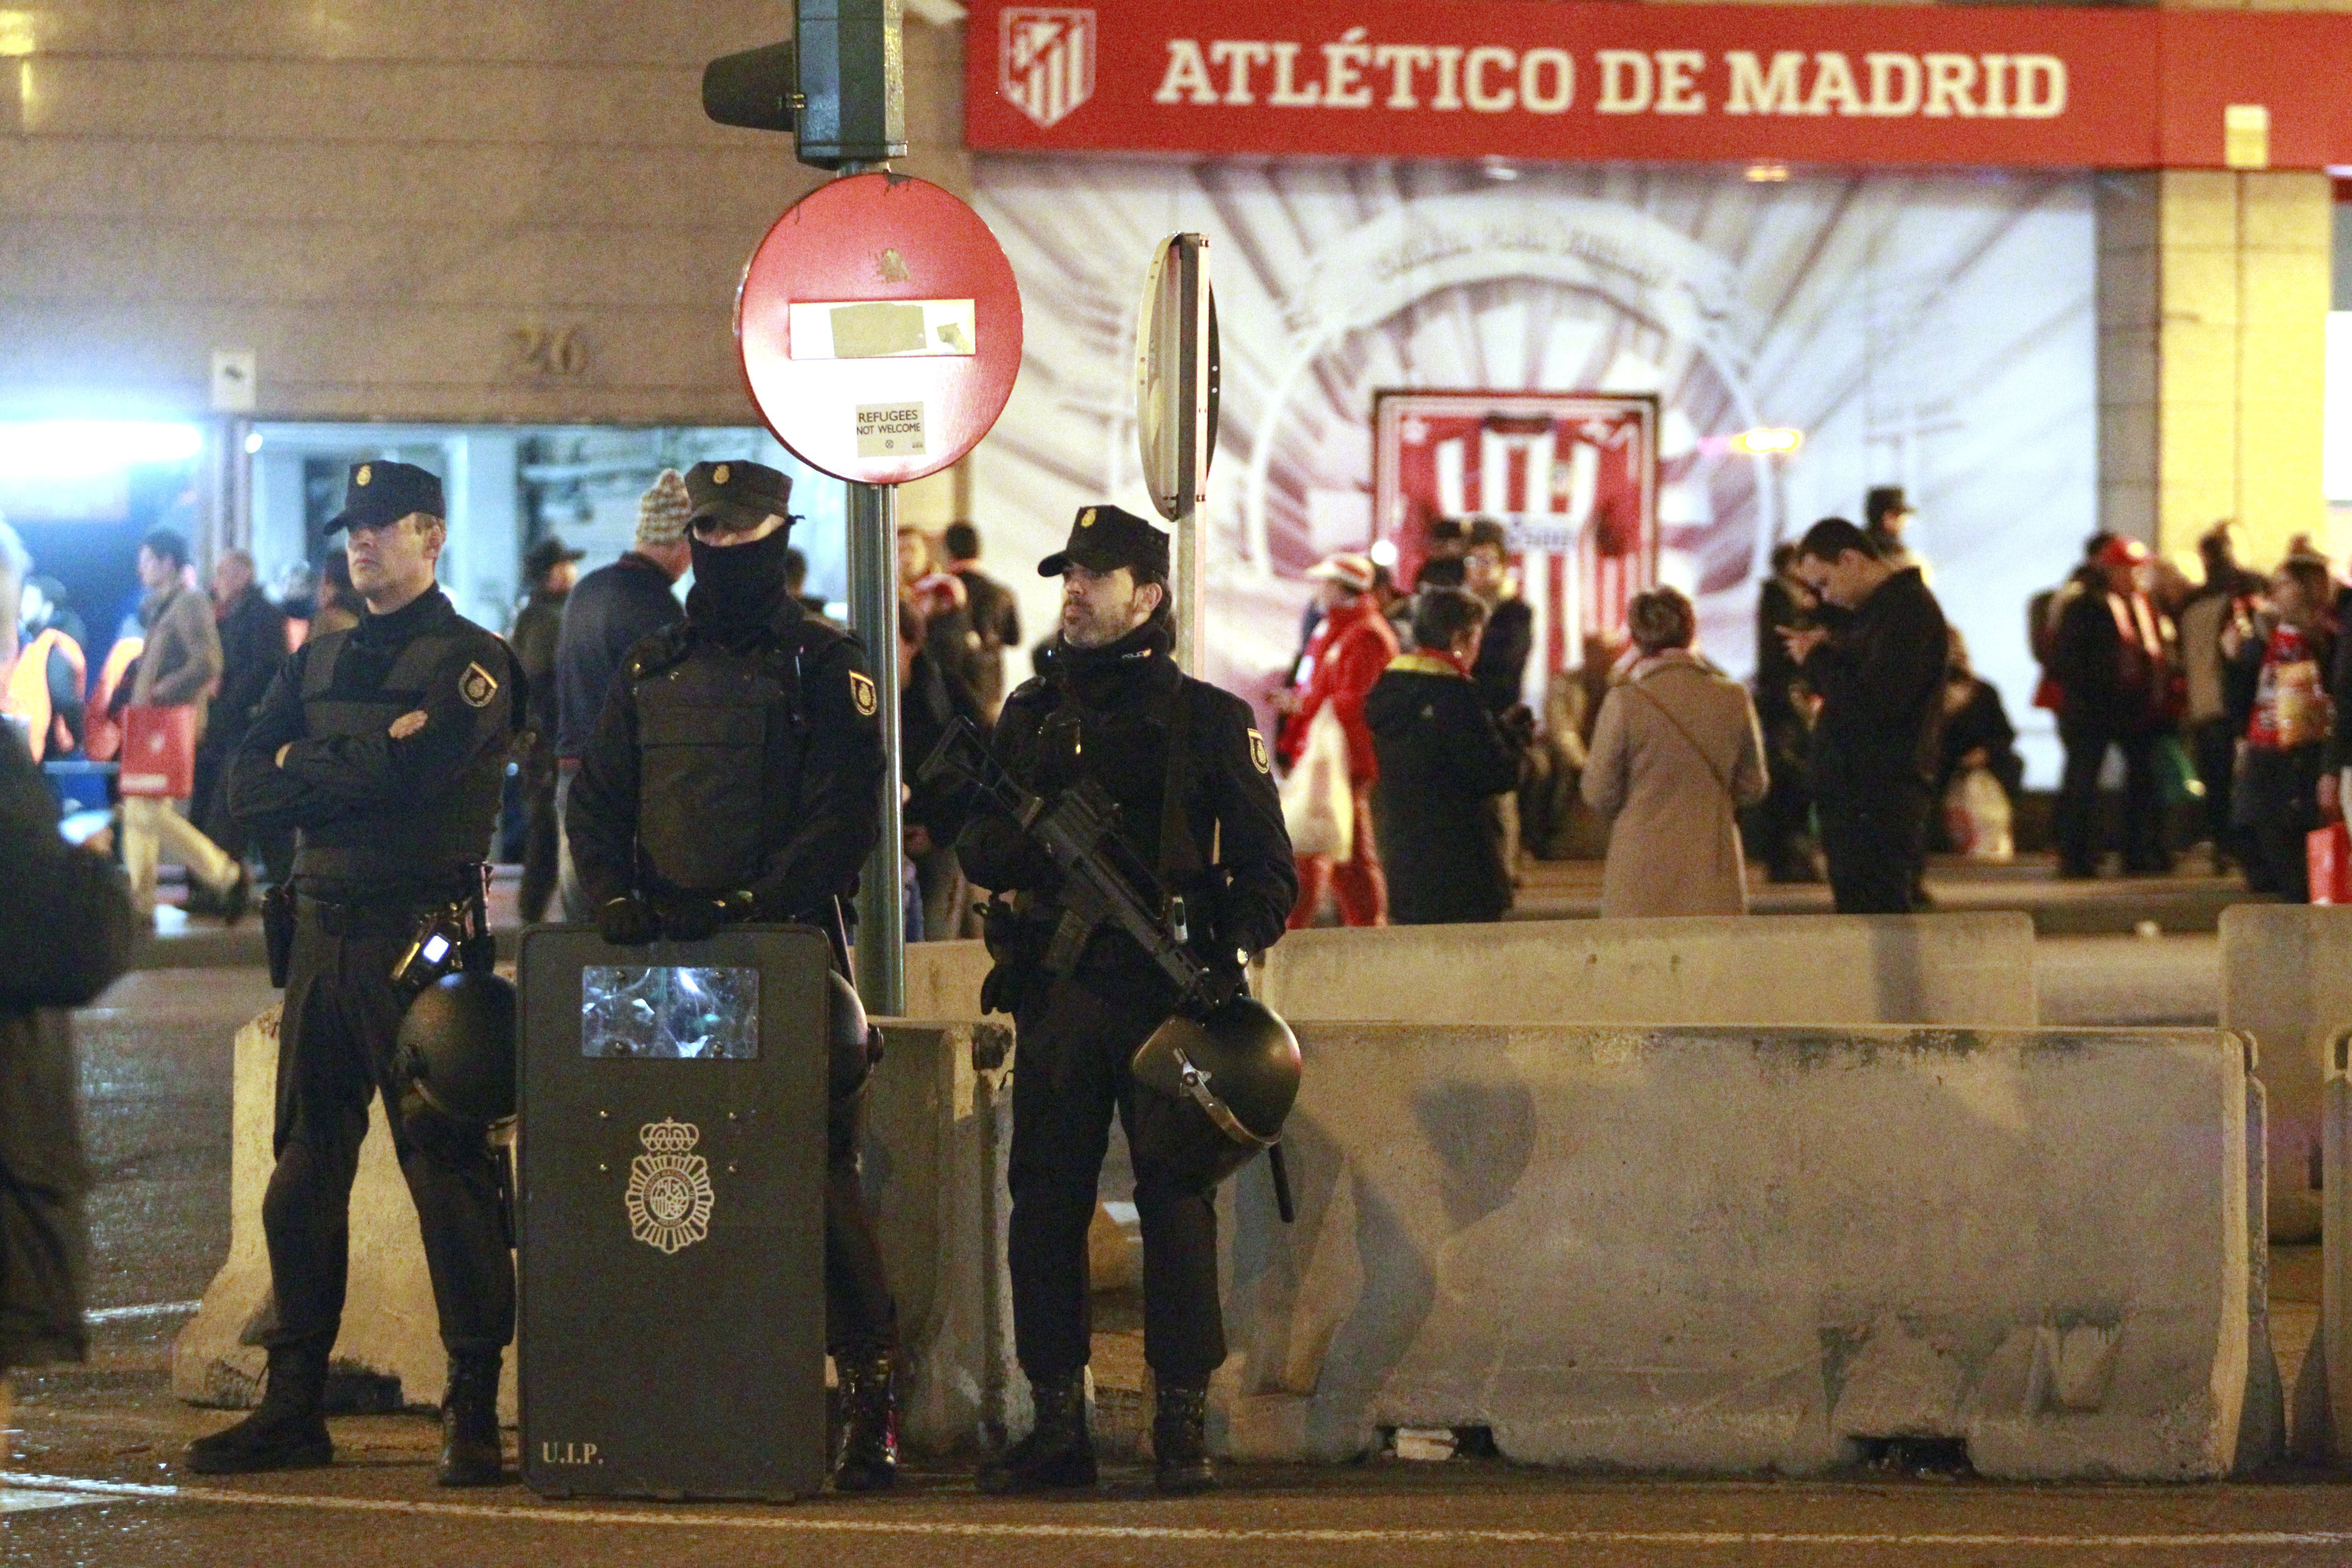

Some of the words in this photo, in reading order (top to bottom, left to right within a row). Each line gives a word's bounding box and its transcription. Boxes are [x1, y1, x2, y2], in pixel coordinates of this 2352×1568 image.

[1154, 27, 1576, 114] ATLÉTICO
[1595, 49, 1707, 115] DE
[1724, 50, 2069, 119] MADRID
[858, 410, 918, 423] REFUGEES
[857, 425, 874, 435] NOT
[878, 423, 921, 434] WELCOME
[542, 1442, 604, 1464] U.I.P.
